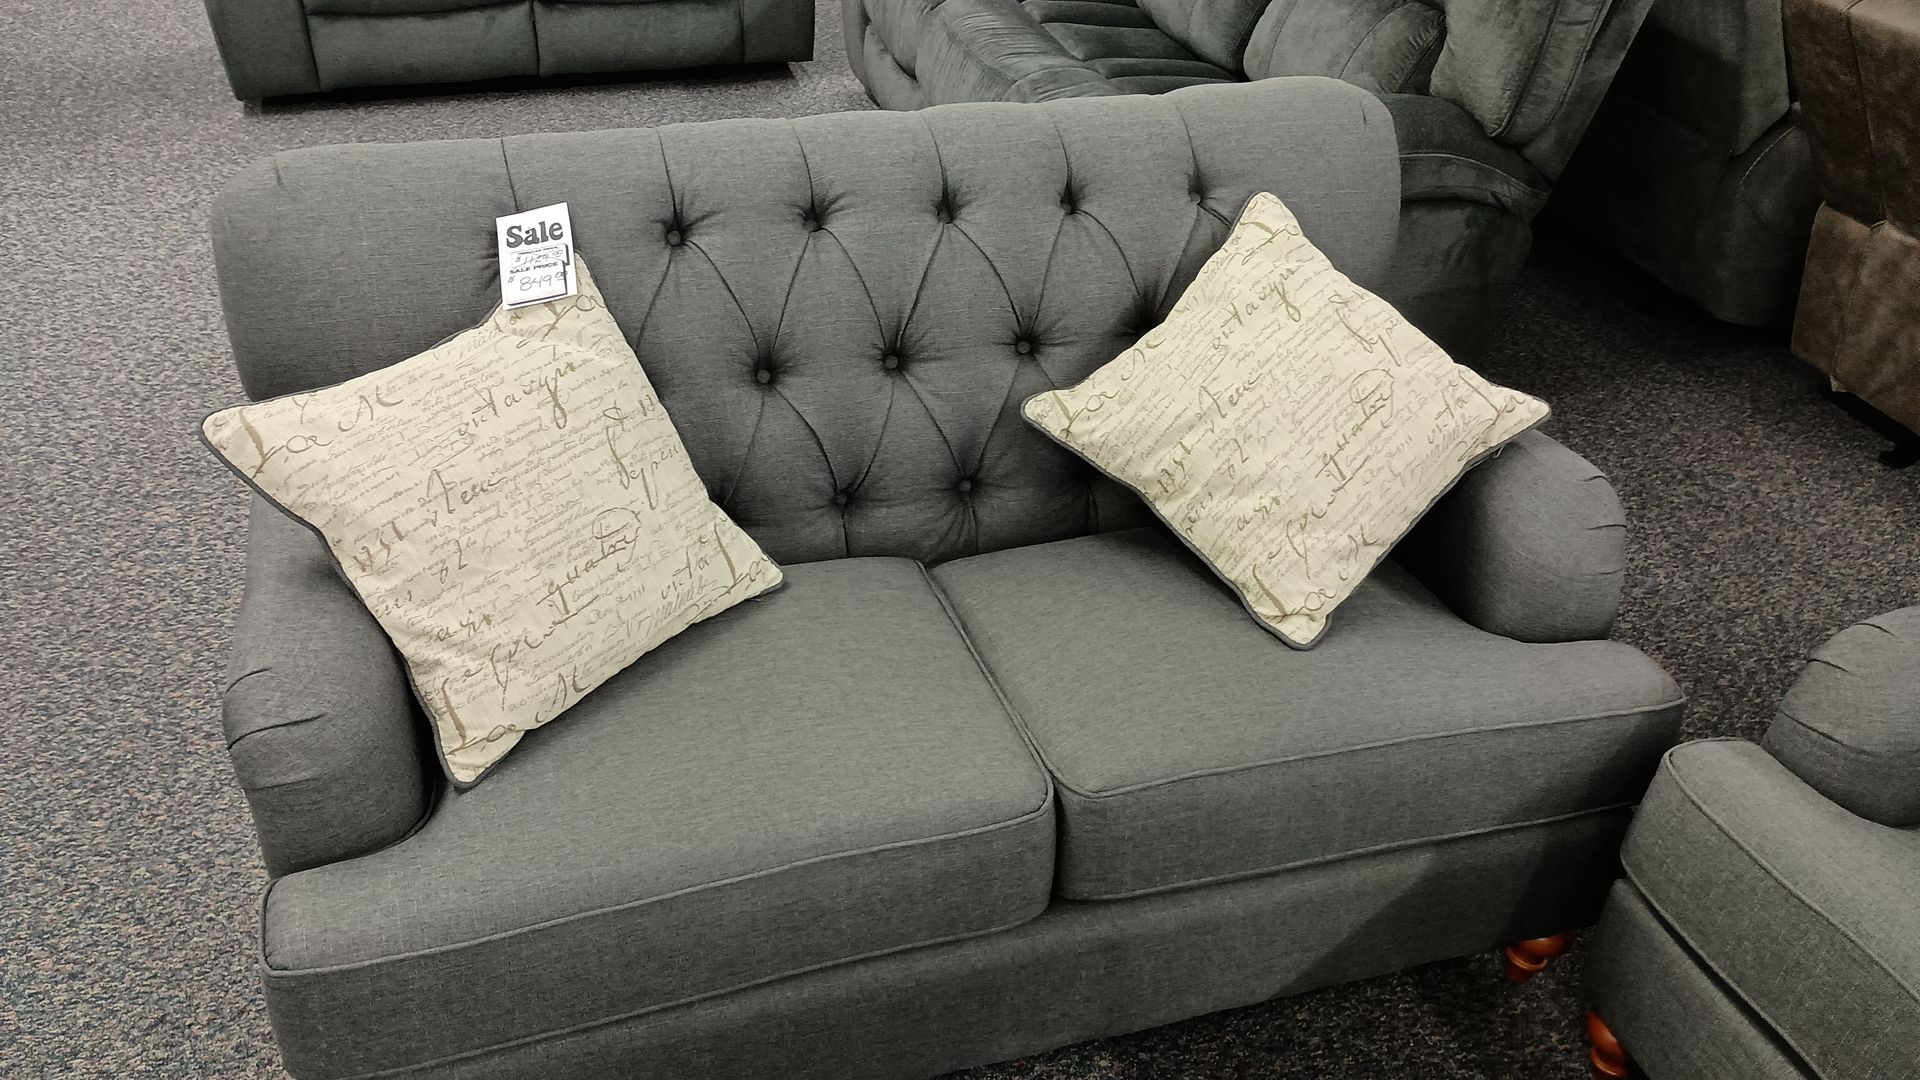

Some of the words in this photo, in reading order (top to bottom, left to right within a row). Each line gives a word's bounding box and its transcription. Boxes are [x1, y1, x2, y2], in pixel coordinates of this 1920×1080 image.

[506, 221, 564, 248] Sale
[510, 266, 530, 274] SALE
[533, 261, 558, 270] PRICE
